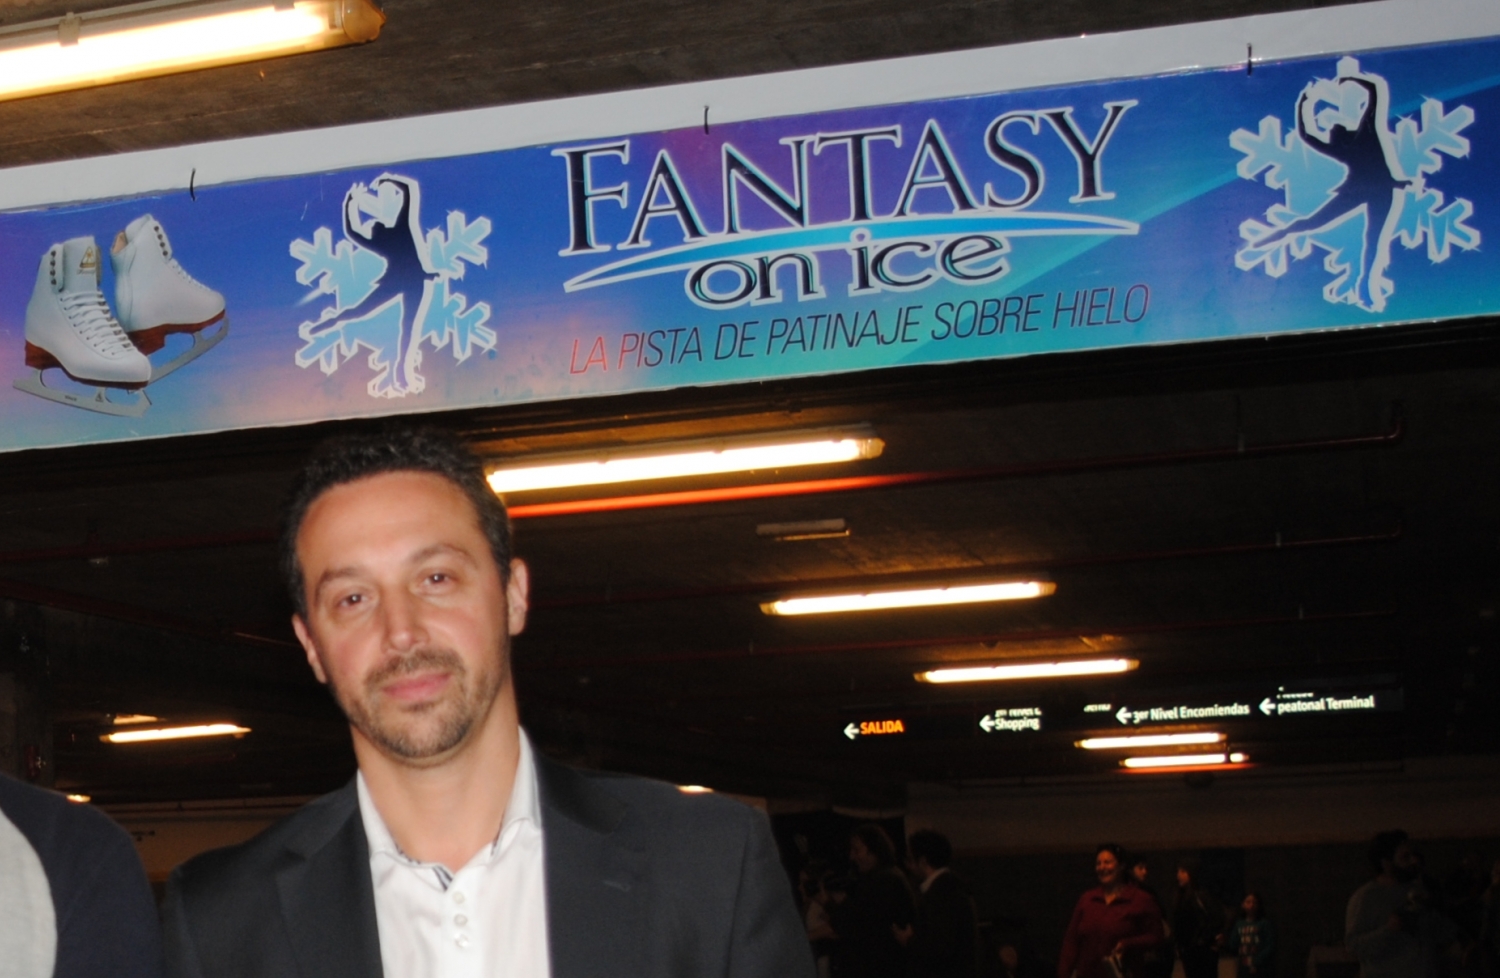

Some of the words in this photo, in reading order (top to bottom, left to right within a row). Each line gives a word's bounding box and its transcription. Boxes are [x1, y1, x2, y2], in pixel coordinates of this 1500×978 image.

[553, 101, 1137, 254] FANTASY
[687, 252, 822, 307] on
[850, 229, 1007, 294] ice
[569, 336, 607, 375] LA
[617, 326, 703, 370] PISTA
[713, 320, 760, 361] DE
[766, 304, 923, 356] PATINAJE
[931, 293, 1045, 341] SOBRE
[1052, 284, 1150, 329] HIELO
[1150, 706, 1178, 720] Nivel
[1180, 702, 1250, 719] Encomiendas
[1277, 698, 1325, 715] peatonal
[1326, 695, 1375, 710] Terminal
[860, 719, 904, 735] SALIDA
[995, 717, 1041, 732] Shopping
